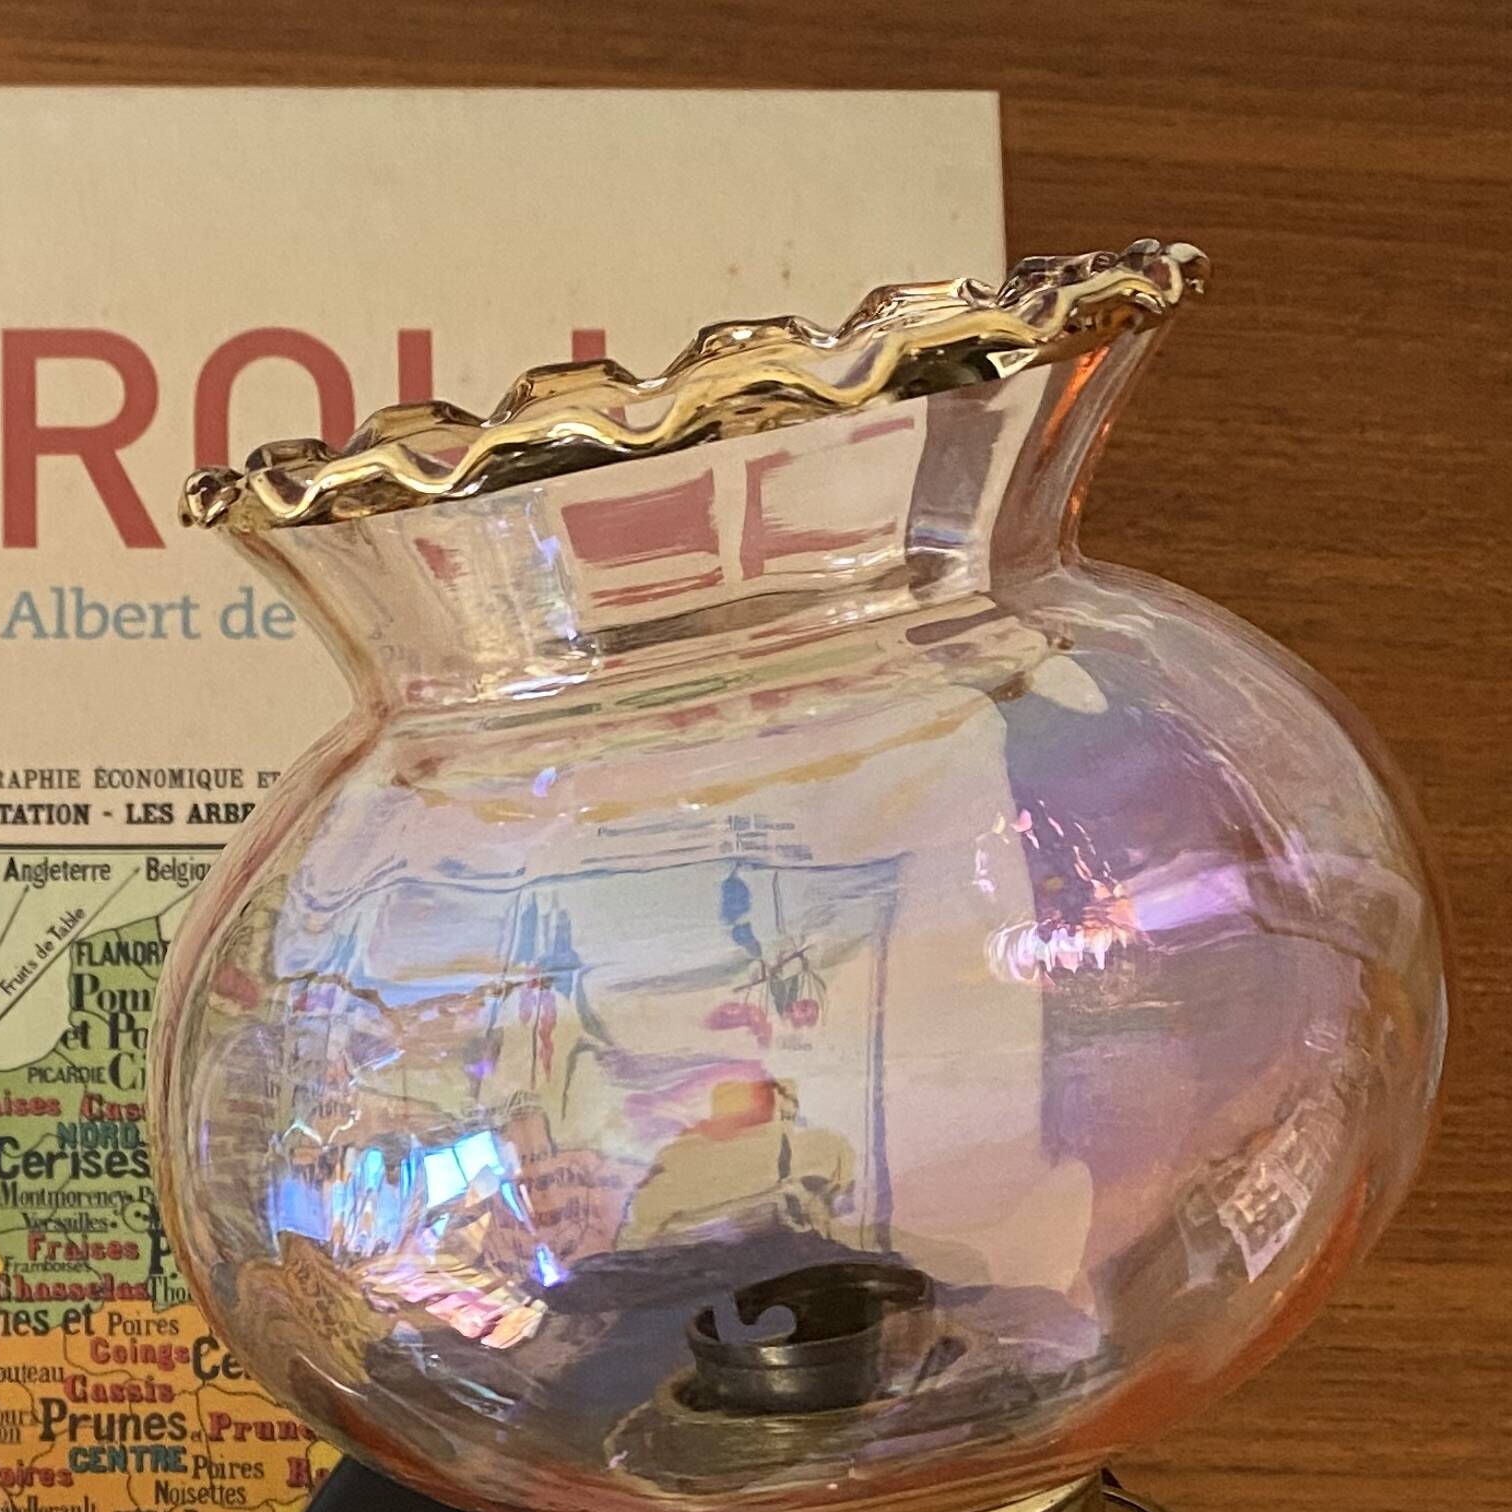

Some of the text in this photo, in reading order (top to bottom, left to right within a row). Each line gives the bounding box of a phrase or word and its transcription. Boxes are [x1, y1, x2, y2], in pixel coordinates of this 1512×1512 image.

[0, 585, 202, 641] Albert
[218, 586, 298, 641] de
[93, 765, 244, 792] ÉCONOMIQUE
[126, 803, 173, 825] LES
[3, 856, 112, 889] Angleterre
[0, 907, 86, 997] Fruits de Table
[27, 1066, 107, 1085] PICARDIE
[27, 1231, 141, 1262] Fraises
[107, 1311, 180, 1337] Poires
[89, 1335, 190, 1372] Coings
[63, 1373, 176, 1404] Cassis
[39, 1397, 188, 1442] Prunes
[68, 1445, 188, 1474] CENTRE
[191, 1453, 265, 1481] Poires
[154, 1480, 247, 1506] Noisettes
